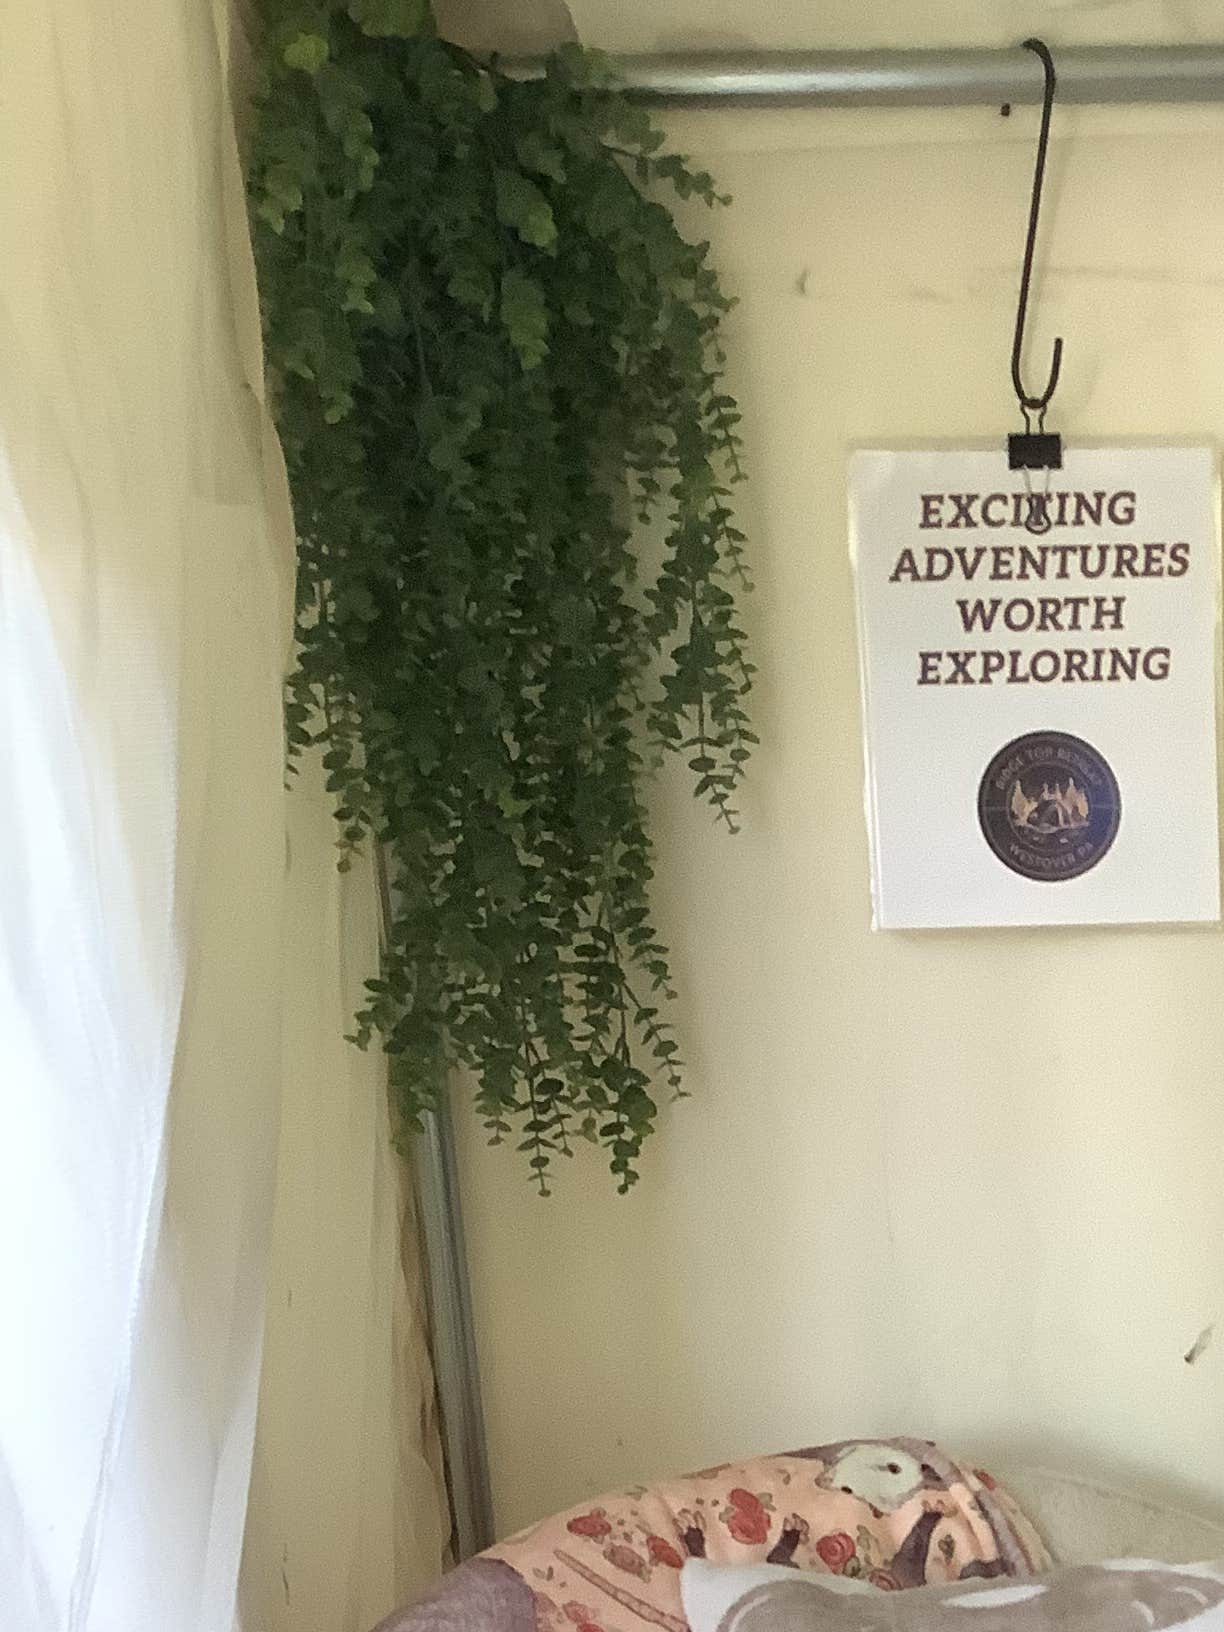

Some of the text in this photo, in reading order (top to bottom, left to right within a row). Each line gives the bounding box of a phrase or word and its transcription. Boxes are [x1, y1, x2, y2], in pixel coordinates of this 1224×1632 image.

[919, 490, 1135, 529] EXCITING
[889, 543, 1190, 582] ADVENTURES
[955, 596, 1126, 632] WORTH
[917, 647, 1170, 685] EXPLORING
